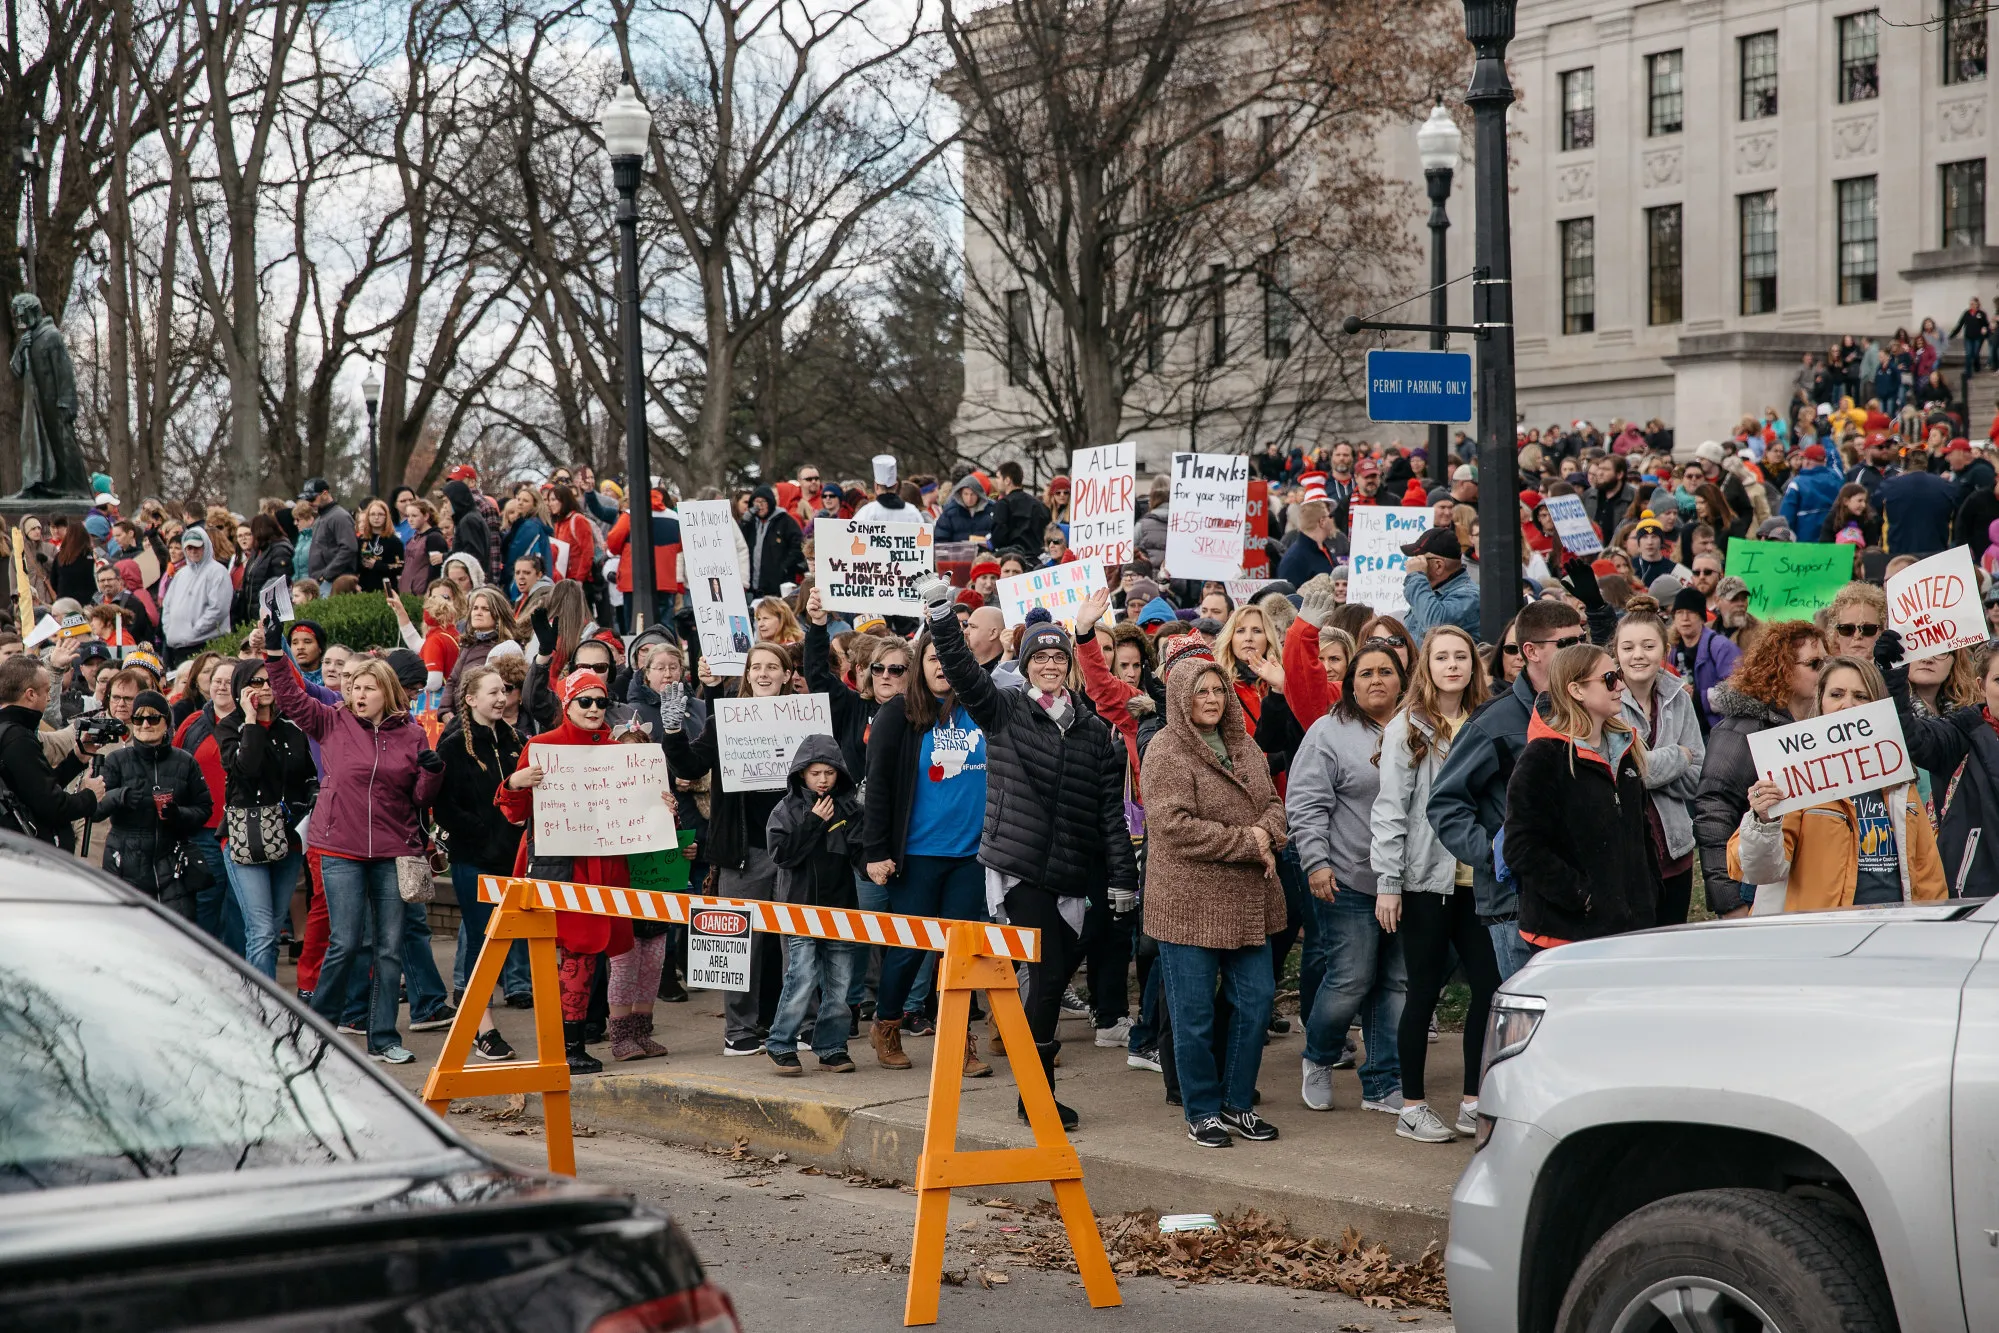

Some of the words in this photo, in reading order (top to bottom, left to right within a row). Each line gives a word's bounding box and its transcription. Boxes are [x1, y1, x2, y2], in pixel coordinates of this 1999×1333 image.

[1373, 379, 1403, 393] PERMIT
[1407, 380, 1442, 394] PARKING
[1446, 381, 1467, 395] ONLY
[1088, 445, 1129, 472] ALL
[1175, 454, 1247, 483] Thanks
[1073, 474, 1134, 521] POWER
[1173, 482, 1189, 500] for
[1196, 493, 1215, 507] your
[1219, 488, 1245, 510] support
[685, 512, 698, 527] IN
[846, 520, 886, 535] SENATE
[1358, 512, 1380, 532] The
[1074, 524, 1093, 543] TO
[1095, 519, 1125, 537] THE
[870, 535, 892, 548] PASS
[894, 536, 916, 549] THE
[829, 557, 848, 572] WE
[853, 562, 882, 574] HAVE
[886, 562, 902, 575] 16
[890, 550, 925, 565] BILL!
[1741, 551, 1764, 575] I
[1774, 556, 1835, 576] Support
[845, 573, 895, 586] MONTHS
[897, 576, 913, 588] TO
[1013, 582, 1020, 597] I
[1026, 571, 1061, 593] LOVE
[1071, 564, 1091, 582] MY
[830, 584, 875, 597] FIGURE
[898, 587, 923, 602] PEI
[1376, 588, 1390, 600] the
[1749, 584, 1770, 612] My
[1891, 575, 1964, 624] UNITED
[699, 607, 712, 623] BE
[715, 608, 725, 627] AN
[1913, 613, 1933, 628] we
[1906, 620, 1957, 651] STAND
[723, 704, 763, 723] DEAR
[774, 698, 826, 724] Mitch,
[725, 734, 778, 747] Investment
[783, 734, 794, 744] in
[934, 727, 966, 740] UNITED
[1778, 732, 1817, 754] we
[1827, 718, 1873, 744] are
[941, 739, 970, 751] STAND
[626, 752, 646, 769] like
[649, 757, 664, 770] you
[724, 750, 771, 761] educators
[723, 765, 736, 777] An
[962, 763, 987, 771] #FundPE
[1767, 739, 1903, 800] UNITED
[571, 781, 577, 791] a
[584, 778, 611, 790] whole
[544, 821, 560, 837] get
[565, 818, 600, 834] better,
[701, 914, 740, 932] DANGER
[691, 938, 747, 955] CONSTRUCTION
[709, 955, 728, 969] AREA
[693, 969, 703, 982] DO
[705, 969, 720, 983] NOT
[721, 971, 744, 985] ENTER
